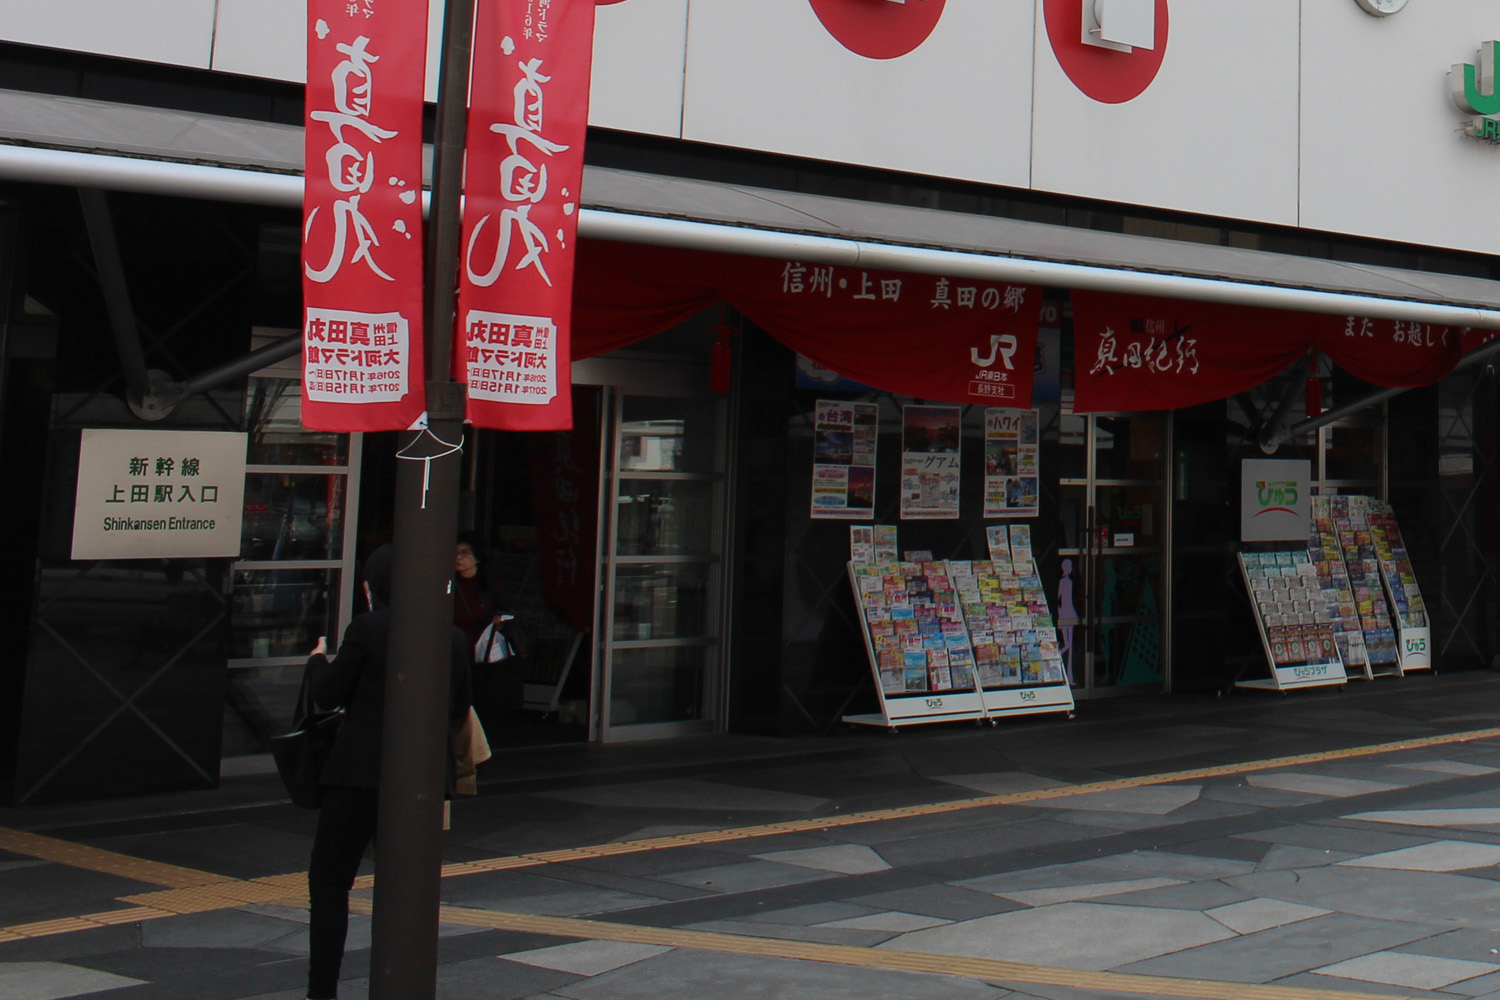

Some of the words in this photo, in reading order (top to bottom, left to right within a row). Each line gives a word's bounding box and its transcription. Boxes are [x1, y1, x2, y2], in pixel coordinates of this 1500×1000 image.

[1344, 316, 1375, 338] また
[970, 333, 1018, 371] JR
[975, 370, 1009, 382] JR東日本
[129, 457, 201, 477] 新幹線
[106, 485, 219, 504] 上田駅入口
[1256, 480, 1299, 507] びゅう
[104, 517, 167, 531] Shinkansen
[169, 517, 216, 530] Entrance
